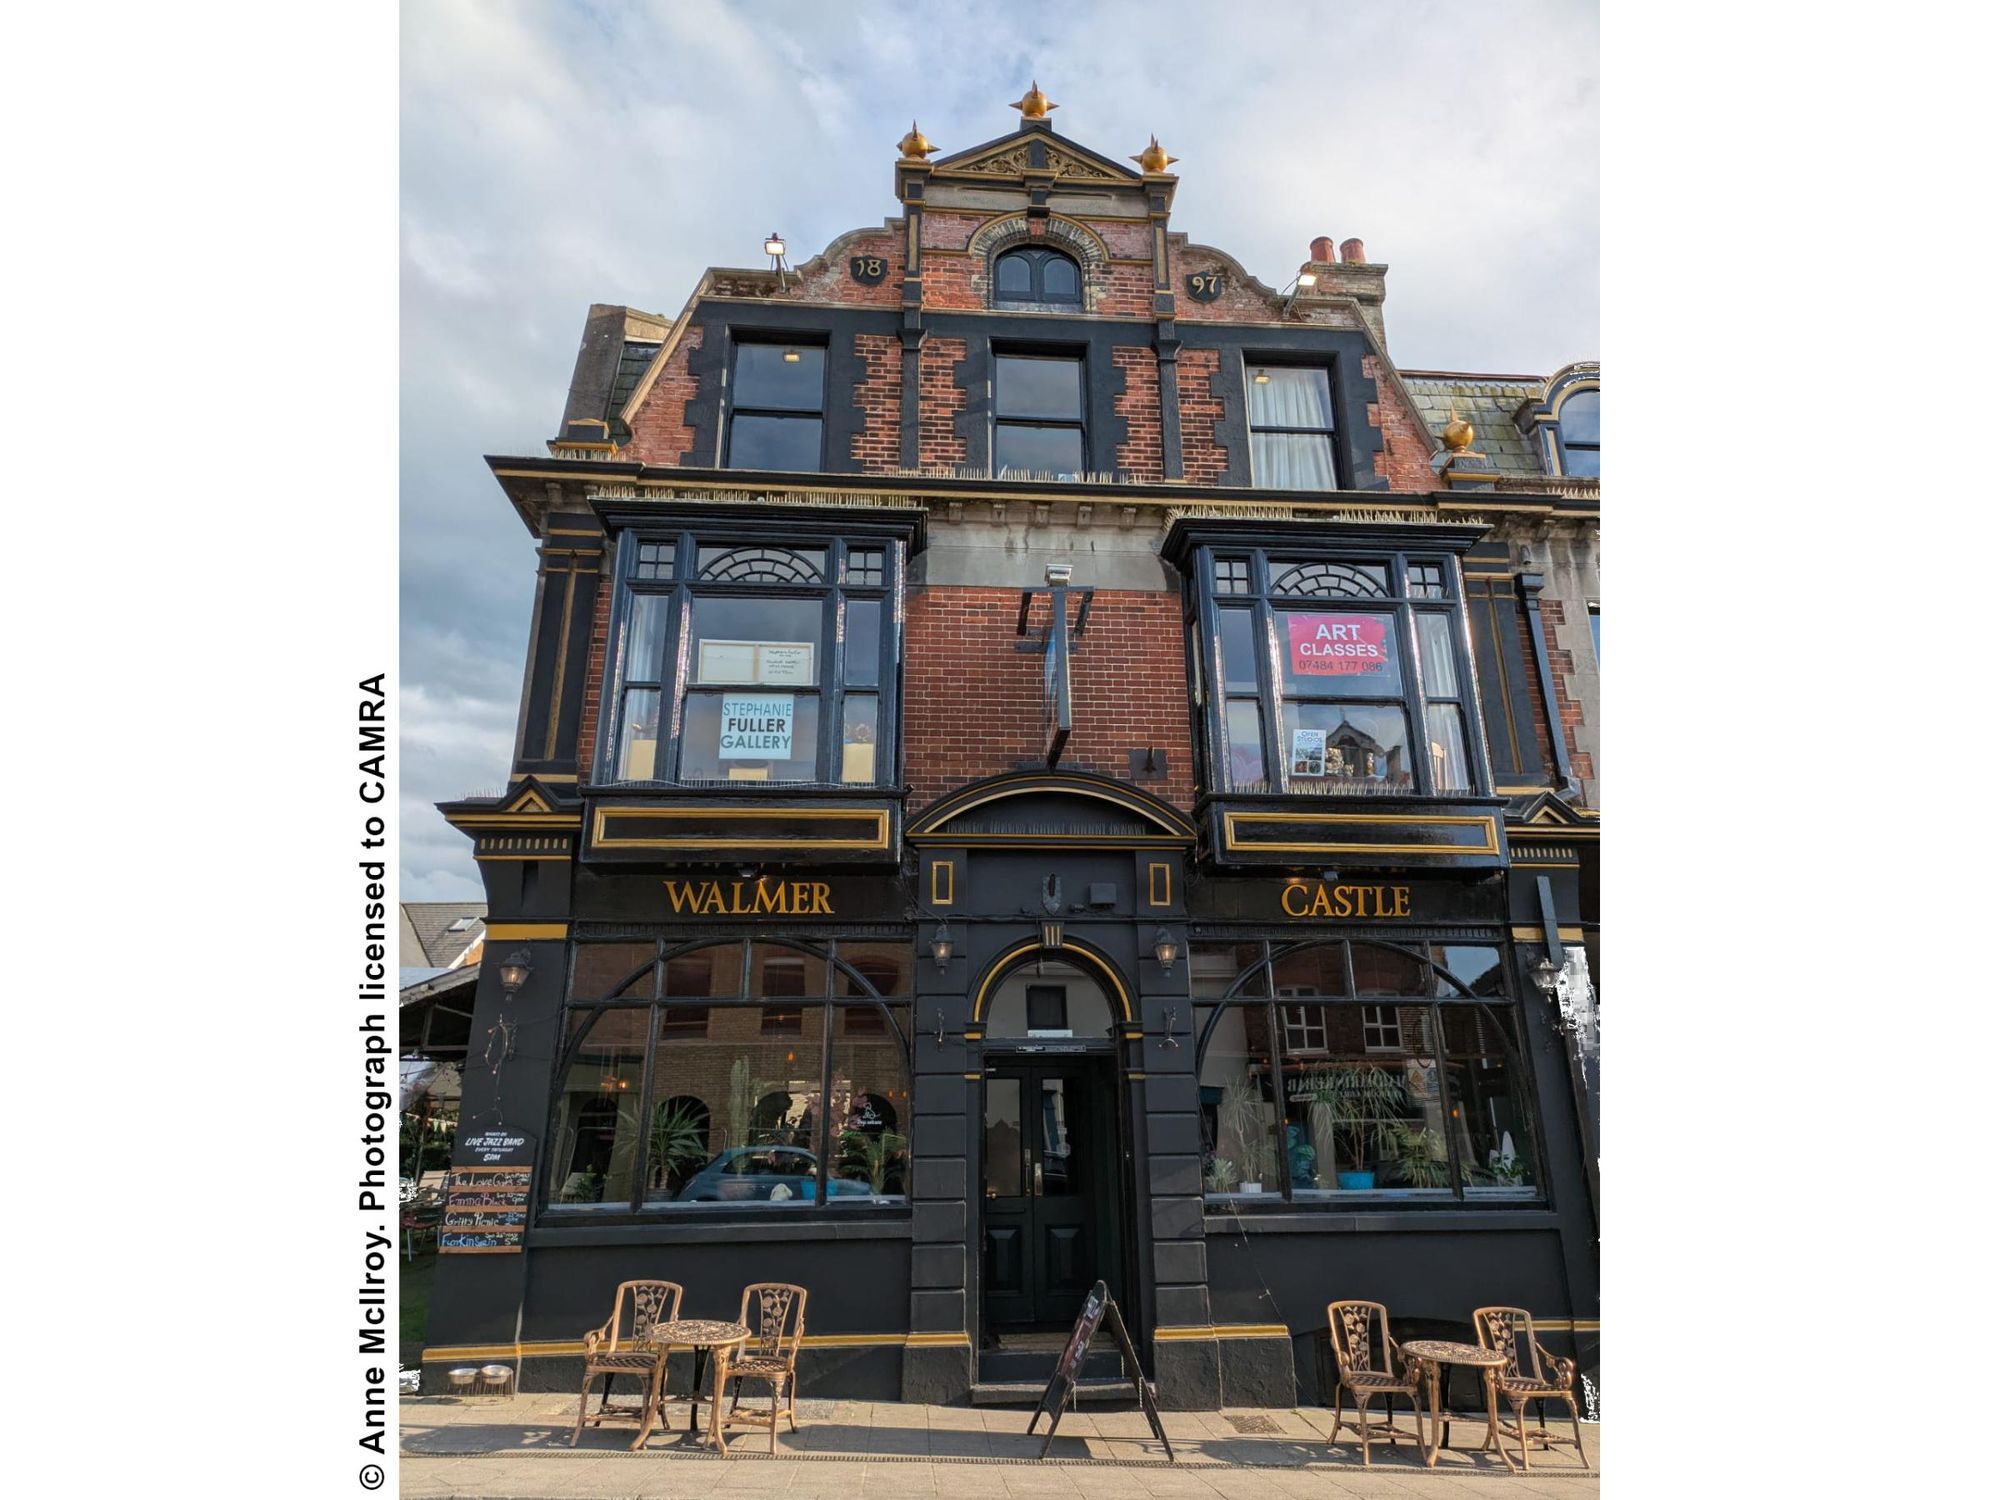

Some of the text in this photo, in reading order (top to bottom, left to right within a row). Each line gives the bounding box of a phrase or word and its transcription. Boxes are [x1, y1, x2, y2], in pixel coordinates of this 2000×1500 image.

[856, 260, 881, 276] 18
[1192, 276, 1217, 294] 97
[1316, 624, 1361, 640] ART
[1300, 643, 1378, 657] CLASSES
[1299, 660, 1383, 672] 07484 177 086
[724, 702, 792, 717] STEPHANIE
[728, 718, 786, 732] FULLER
[720, 735, 791, 749] GALLERY
[663, 880, 835, 914] WALMER
[1281, 884, 1411, 917] CASTLE
[465, 1138, 525, 1146] LIVE JAZZ BAND
[449, 1193, 480, 1206] Emma
[474, 1212, 499, 1226] Picnic
